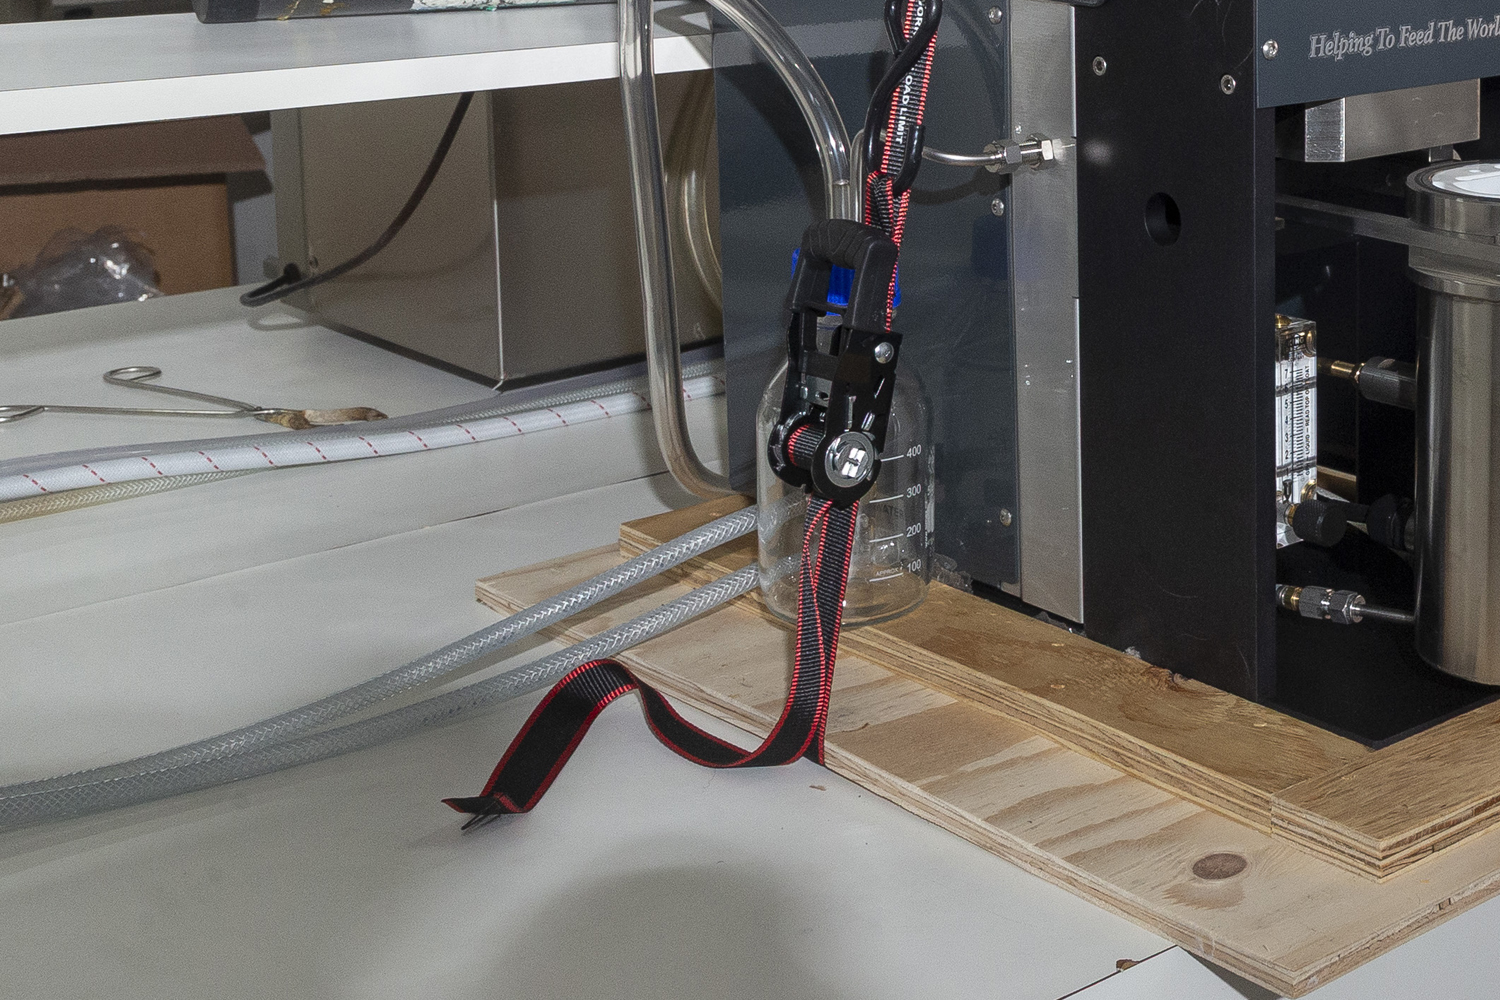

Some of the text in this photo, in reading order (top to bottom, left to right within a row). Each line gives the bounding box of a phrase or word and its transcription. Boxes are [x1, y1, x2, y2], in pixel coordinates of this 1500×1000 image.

[1308, 31, 1374, 62] Helping
[1376, 26, 1396, 50] To
[1399, 20, 1434, 48] Feed
[1438, 18, 1464, 43] The
[895, 107, 908, 145] LIMIT
[906, 444, 922, 458] 400
[906, 483, 922, 498] 300
[906, 522, 922, 538] 200
[907, 559, 922, 574] 100
